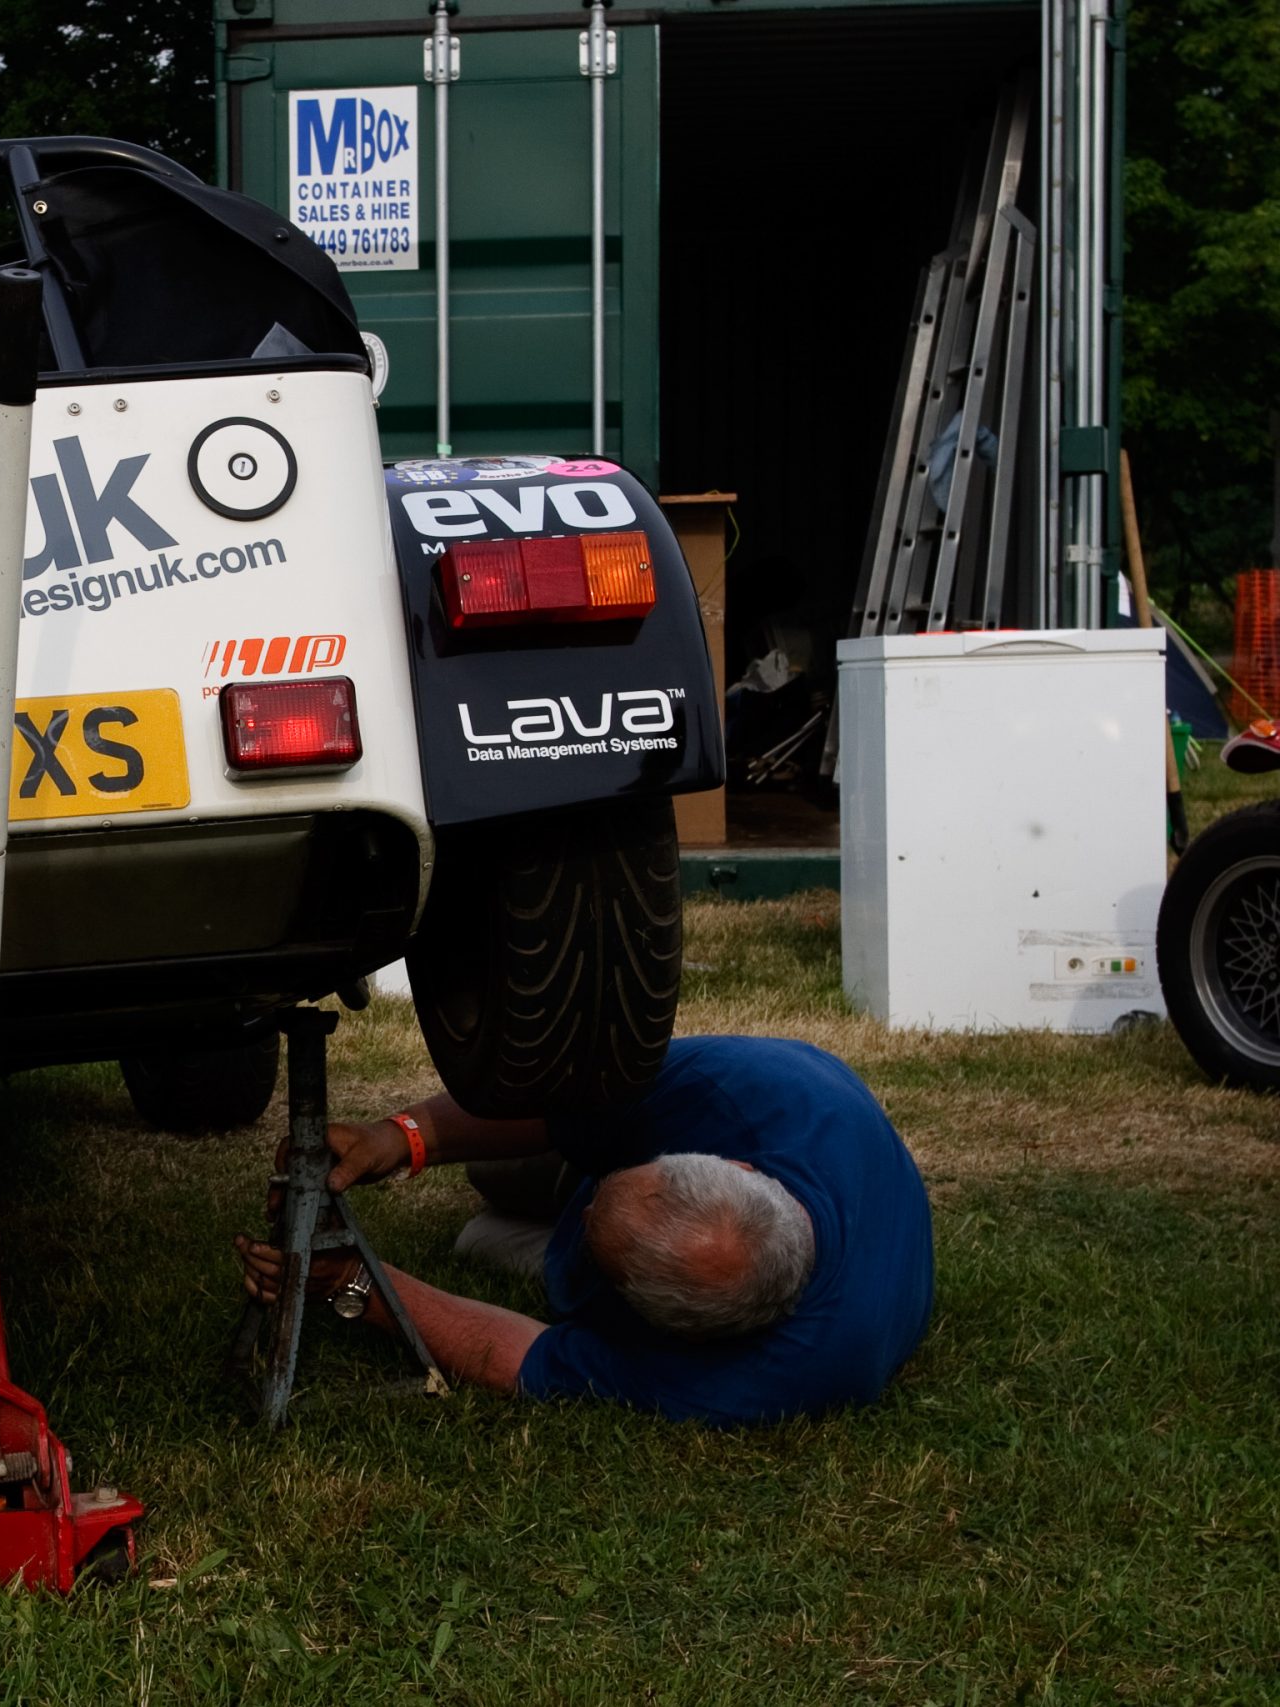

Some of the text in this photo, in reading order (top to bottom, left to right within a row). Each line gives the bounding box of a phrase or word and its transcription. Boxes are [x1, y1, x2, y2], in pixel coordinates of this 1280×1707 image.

[298, 180, 411, 201] CONTAINER
[298, 202, 411, 223] SALES & HIRE
[352, 227, 410, 255] 761783
[561, 463, 603, 473] 24
[401, 482, 636, 537] evo
[467, 736, 678, 762] Data Management Systems
